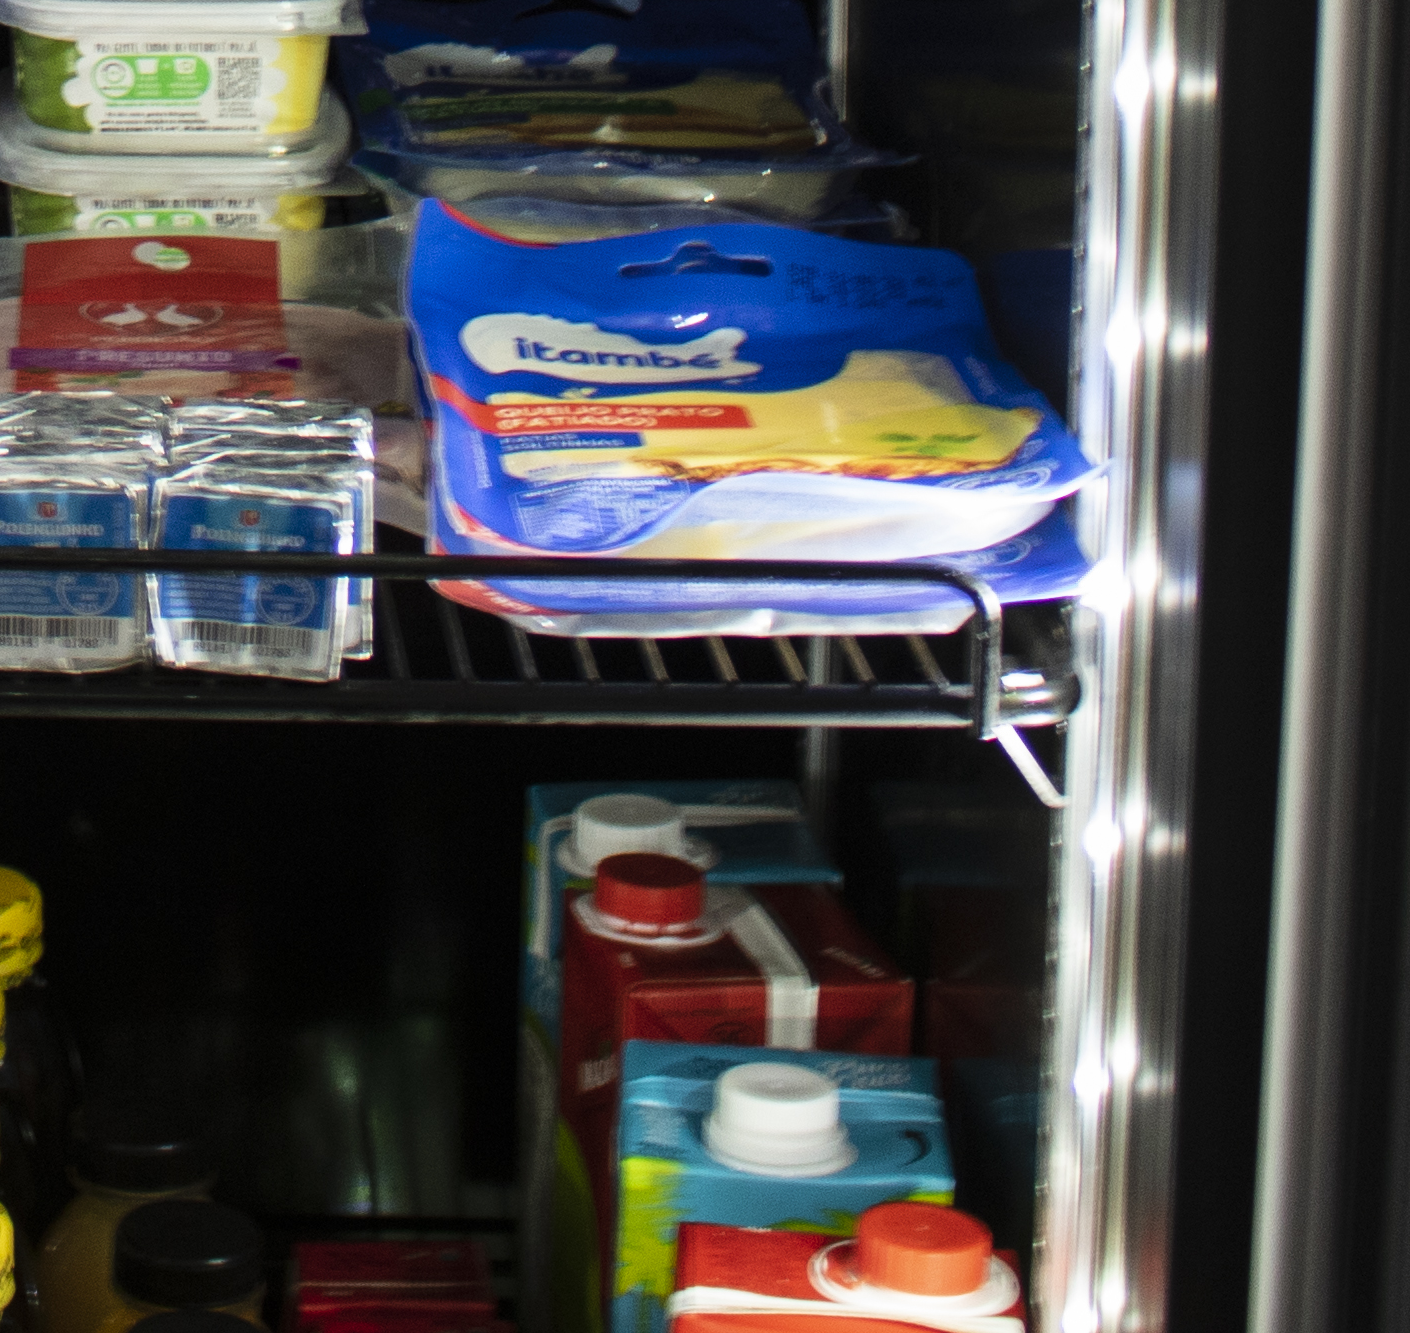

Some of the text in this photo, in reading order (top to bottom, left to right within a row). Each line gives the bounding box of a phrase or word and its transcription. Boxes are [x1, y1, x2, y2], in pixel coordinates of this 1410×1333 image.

[513, 336, 721, 370] itambé
[493, 405, 725, 418] QUEIJO PRATO
